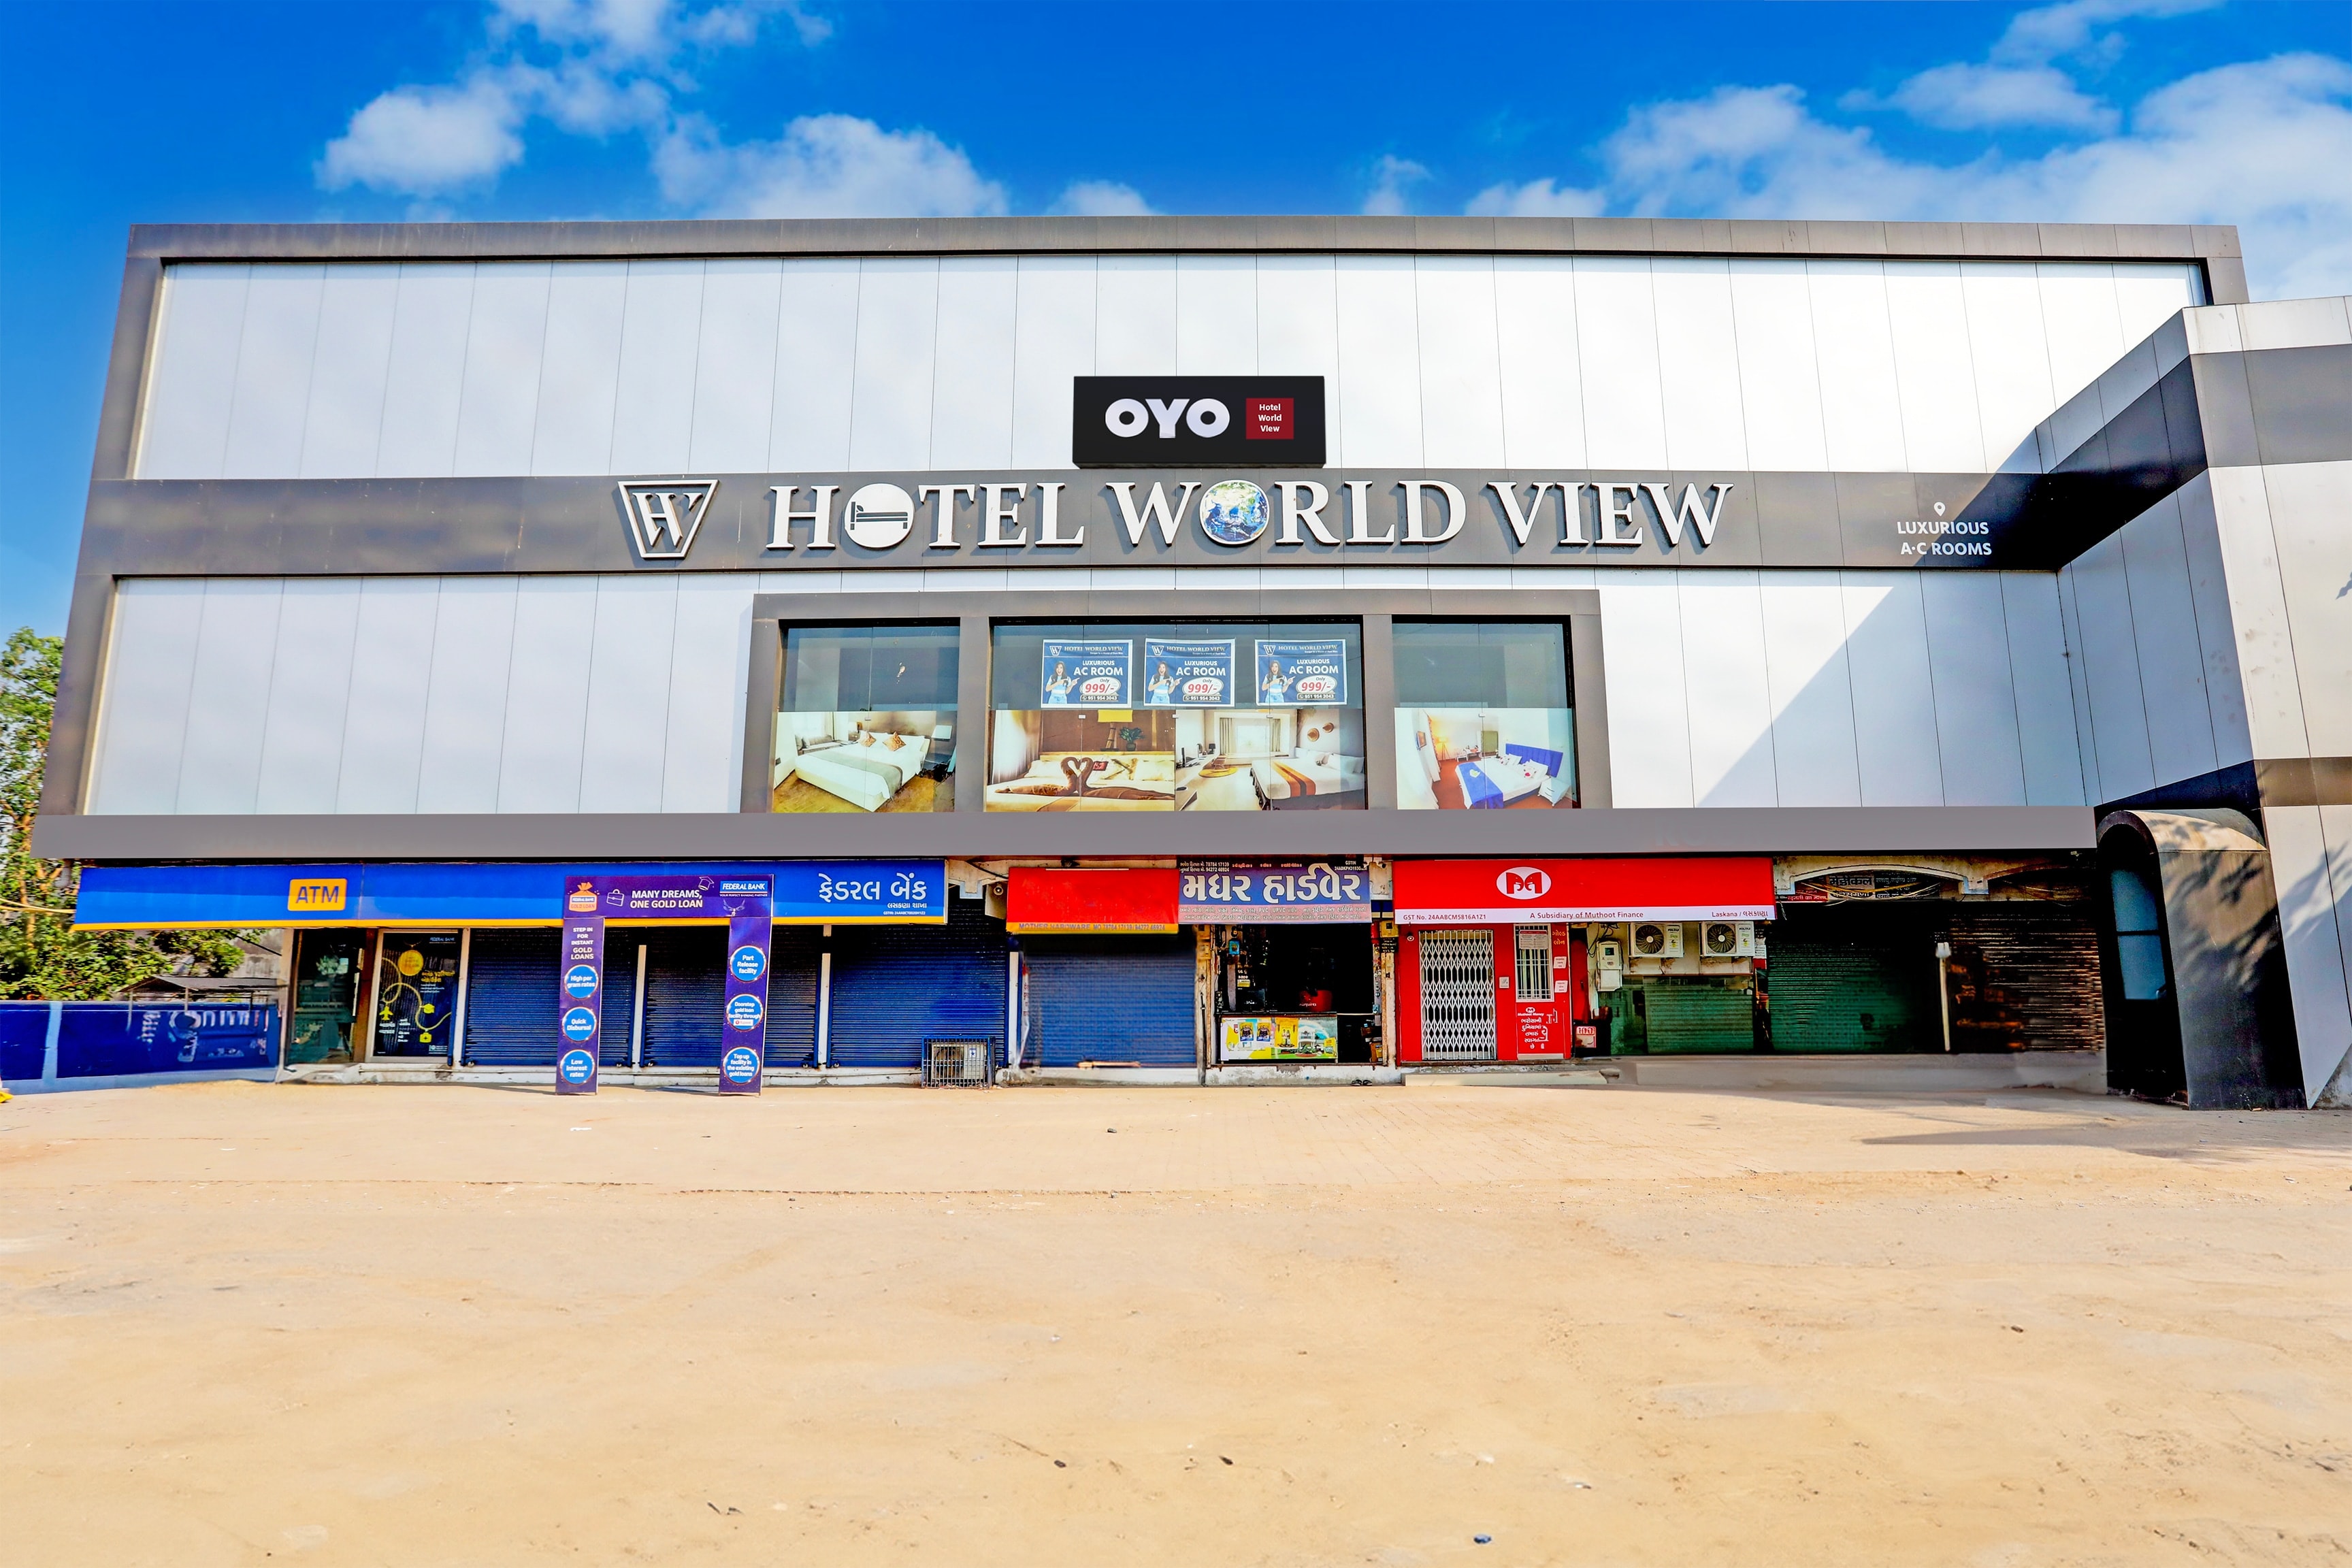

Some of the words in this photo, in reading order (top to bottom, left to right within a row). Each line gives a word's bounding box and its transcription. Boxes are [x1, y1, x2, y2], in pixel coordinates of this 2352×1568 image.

[1105, 398, 1230, 438] OYO
[766, 482, 1085, 550] HOTEL
[1106, 479, 1467, 546] WORLD
[1487, 482, 1734, 546] VIEW
[1897, 521, 1989, 534] LUXURIOUS
[1931, 542, 1992, 555] ROOMS
[1073, 667, 1088, 675] AC
[1091, 667, 1123, 675] ROOM
[1193, 668, 1226, 676] ROOM
[1289, 666, 1303, 674] AC
[1307, 666, 1339, 674] ROOM
[1085, 683, 1114, 693] 999/-
[1188, 683, 1217, 693] 999/-
[1301, 682, 1330, 691] 999/-
[818, 872, 881, 902] ફેડરલ
[890, 872, 927, 900] બેંક
[1183, 873, 1252, 902] મધર
[295, 885, 340, 904] ATM
[632, 890, 659, 898] MANY
[662, 889, 702, 899] DREAMS,
[630, 900, 649, 909] ONE
[653, 900, 675, 909] GOLD
[679, 900, 703, 908] LOAN
[1537, 911, 1574, 919] Subsidiary
